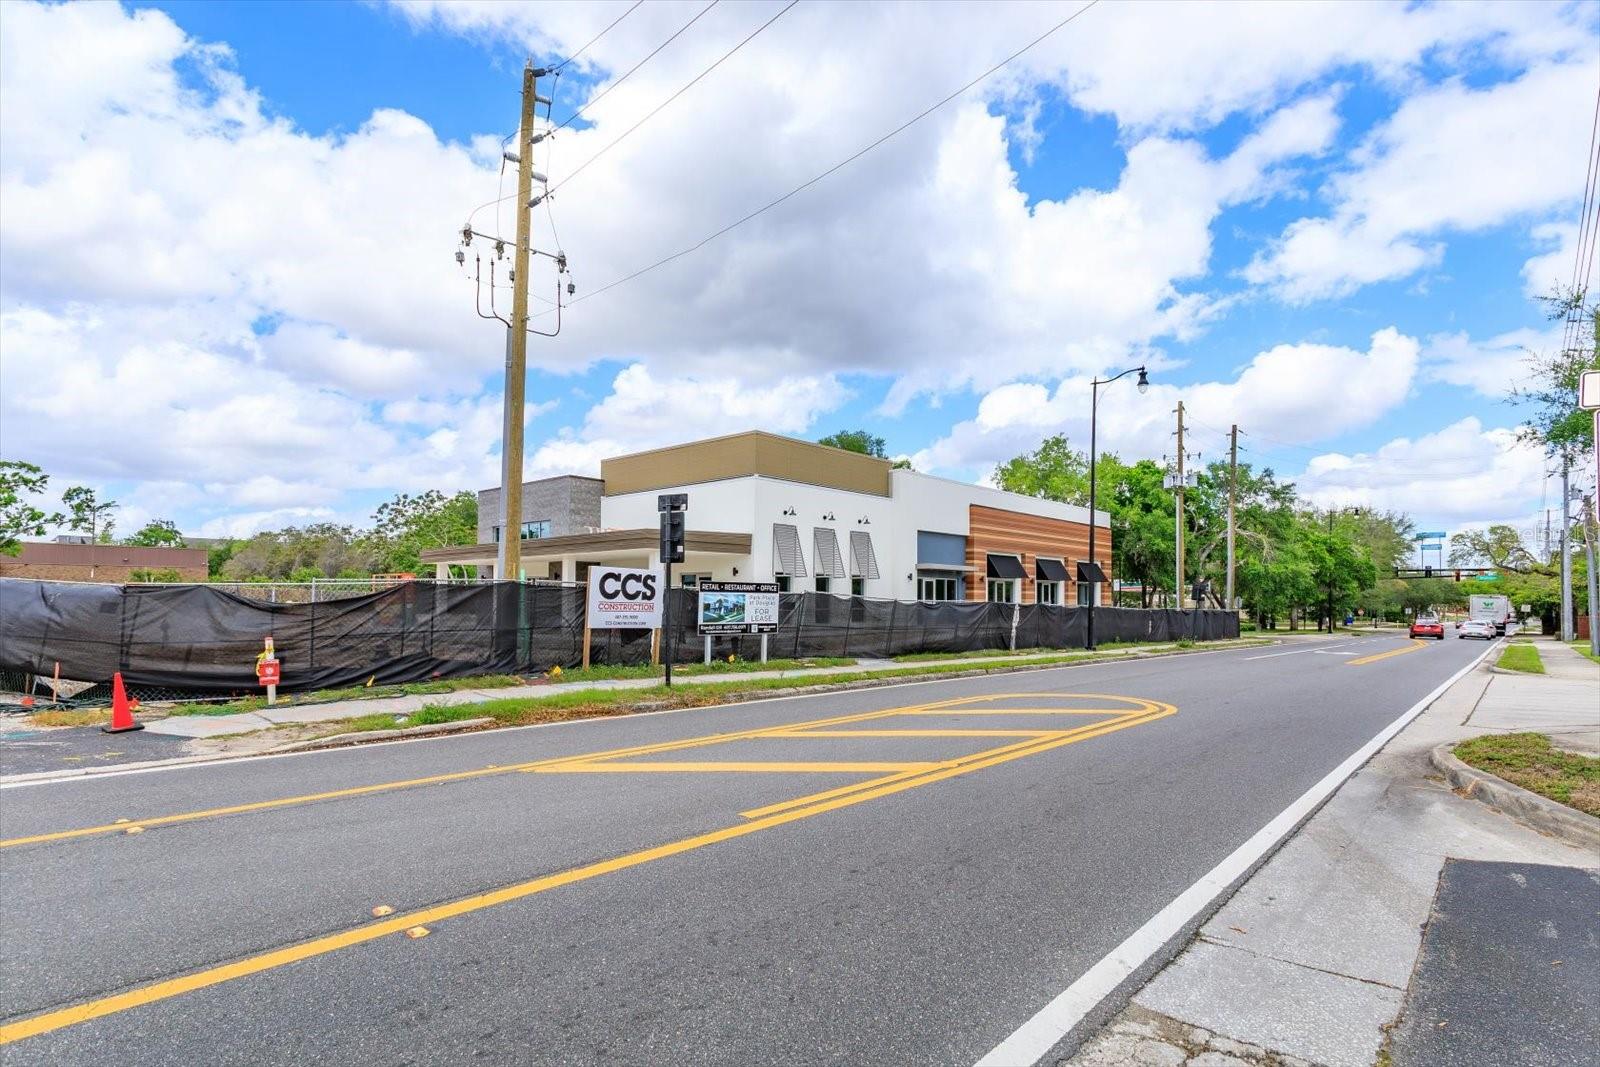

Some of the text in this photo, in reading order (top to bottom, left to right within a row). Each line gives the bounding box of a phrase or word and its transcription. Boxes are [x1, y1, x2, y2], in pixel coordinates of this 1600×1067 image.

[599, 572, 656, 601] CCS
[701, 583, 720, 591] RETAIL
[598, 602, 655, 612] CONSTRUCTION
[751, 614, 774, 622] LEASE
